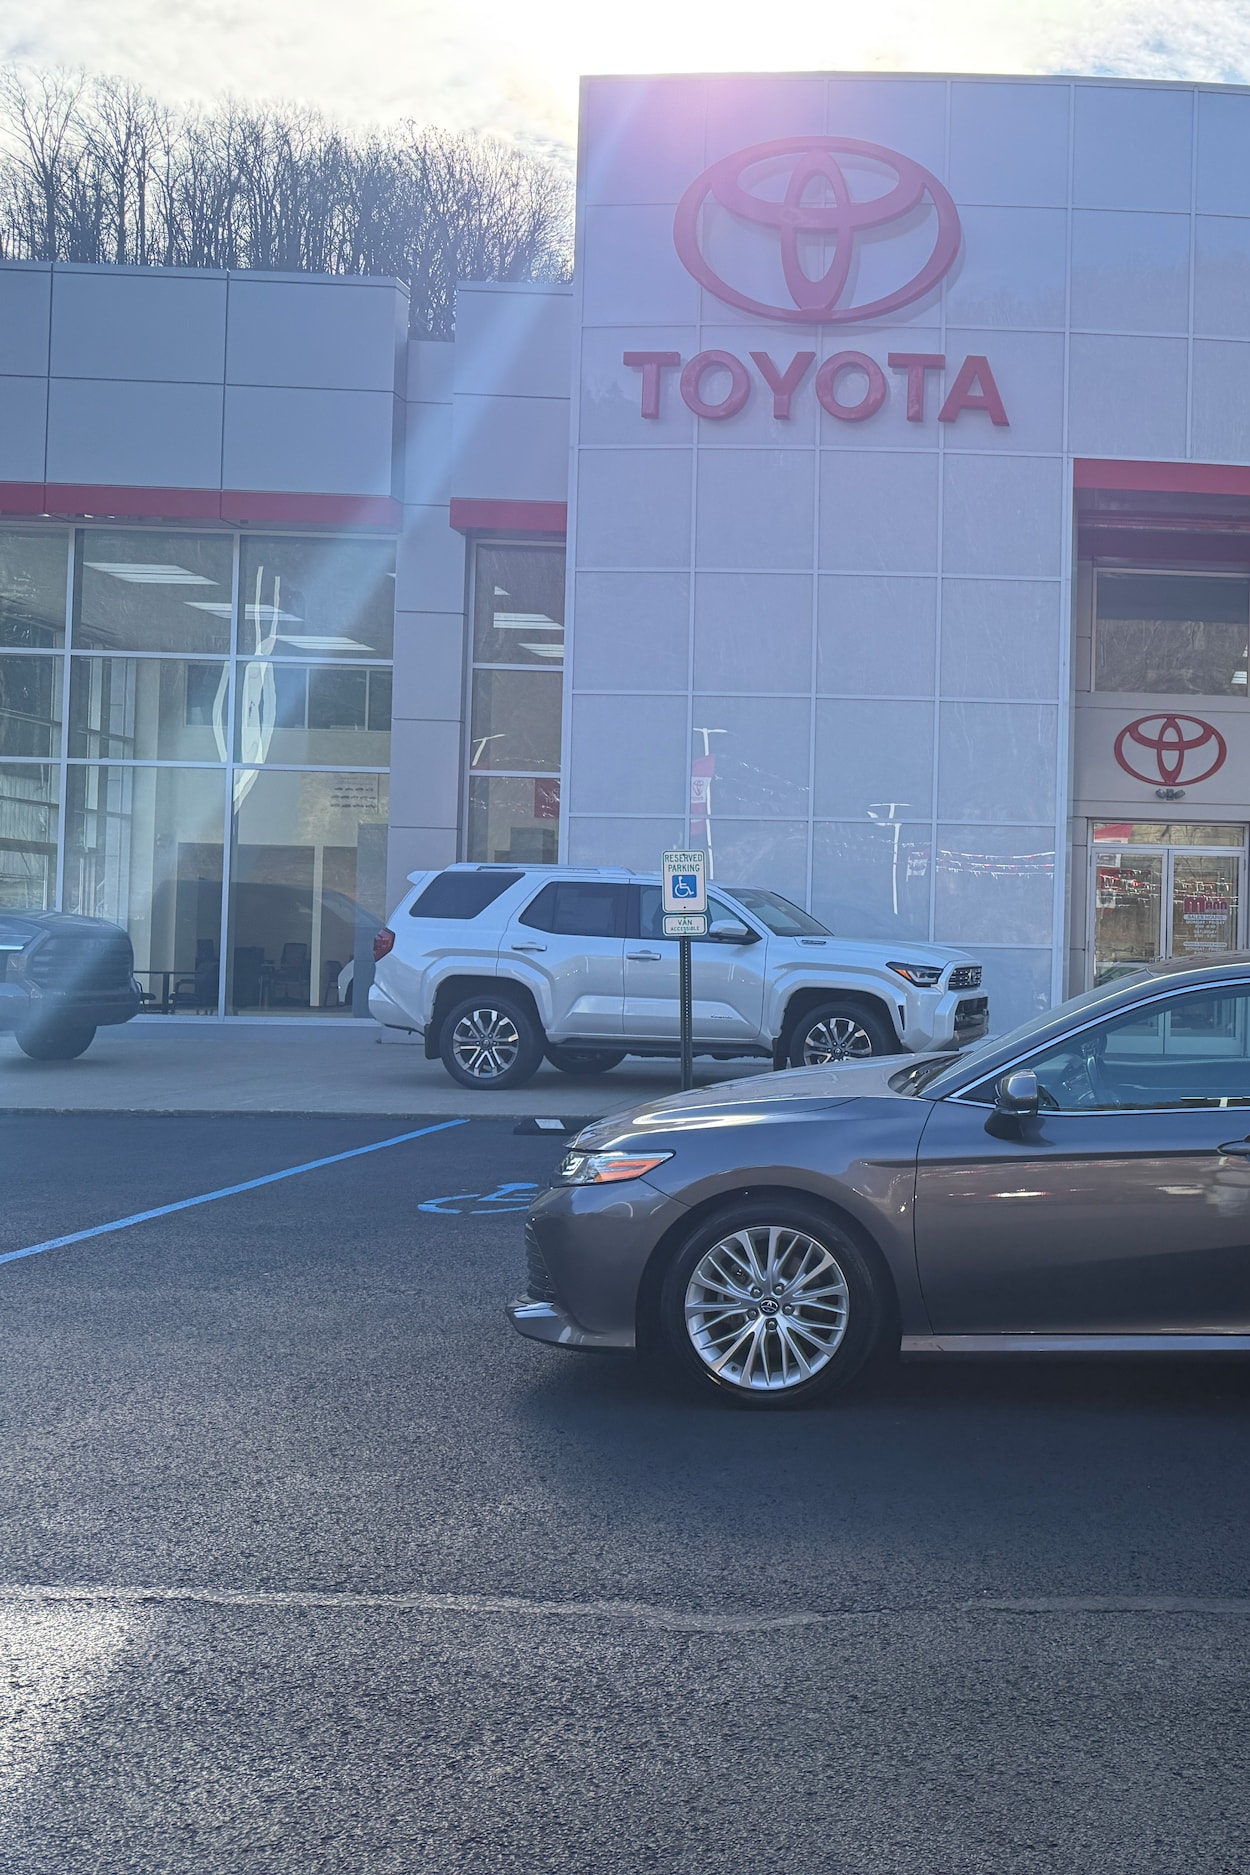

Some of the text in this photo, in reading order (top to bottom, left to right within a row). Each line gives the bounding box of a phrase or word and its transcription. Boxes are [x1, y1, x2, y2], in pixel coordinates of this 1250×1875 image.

[623, 349, 1010, 427] TOYOTA
[664, 853, 703, 863] RESERVED
[667, 863, 700, 873] PARKING
